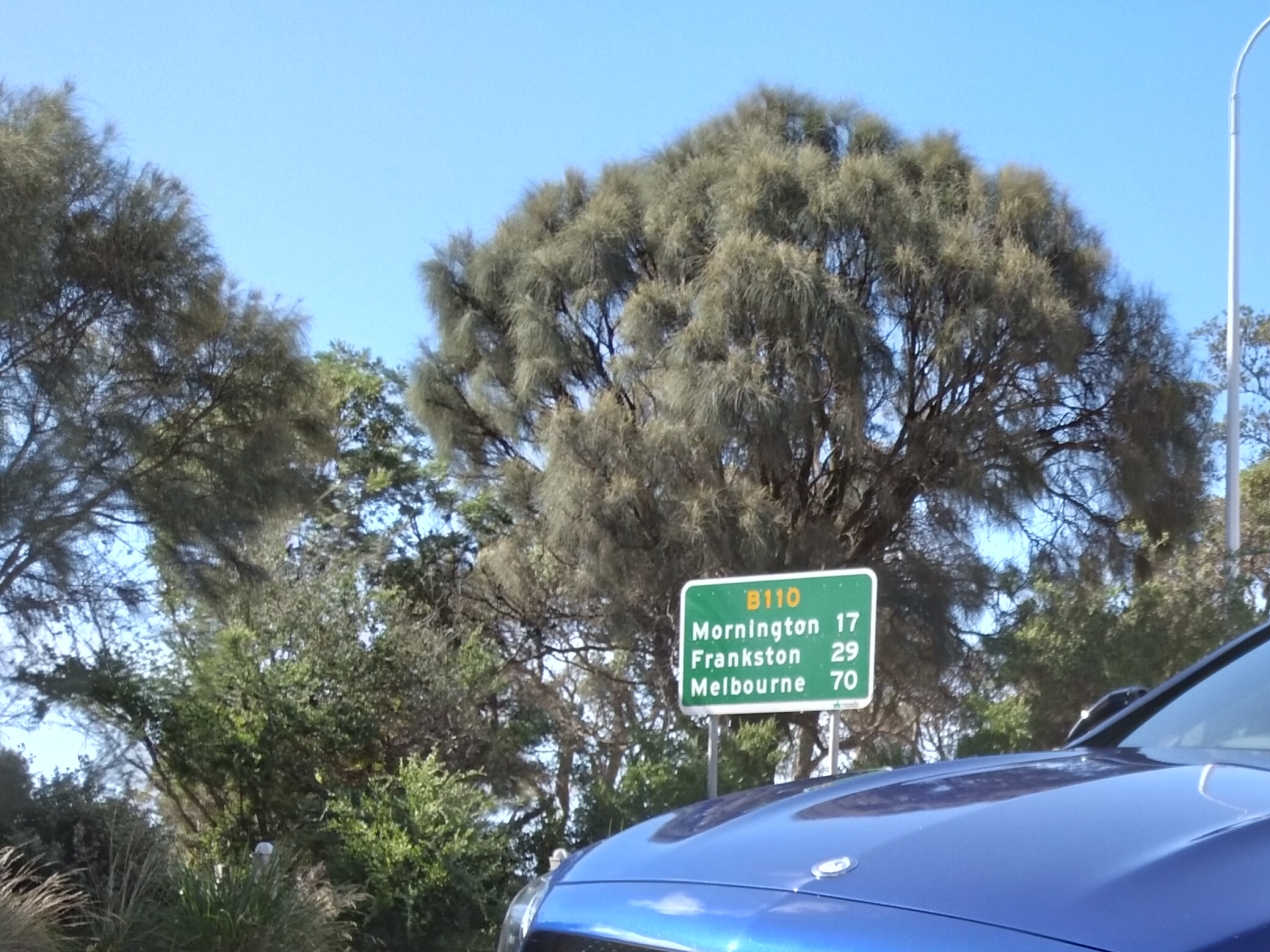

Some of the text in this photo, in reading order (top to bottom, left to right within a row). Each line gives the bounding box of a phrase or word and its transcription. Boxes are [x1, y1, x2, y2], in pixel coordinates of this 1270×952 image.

[747, 587, 801, 610] B110
[692, 612, 860, 642] Mornington 17
[691, 641, 859, 669] Frankston 29
[690, 670, 858, 697] Melbourne 70
